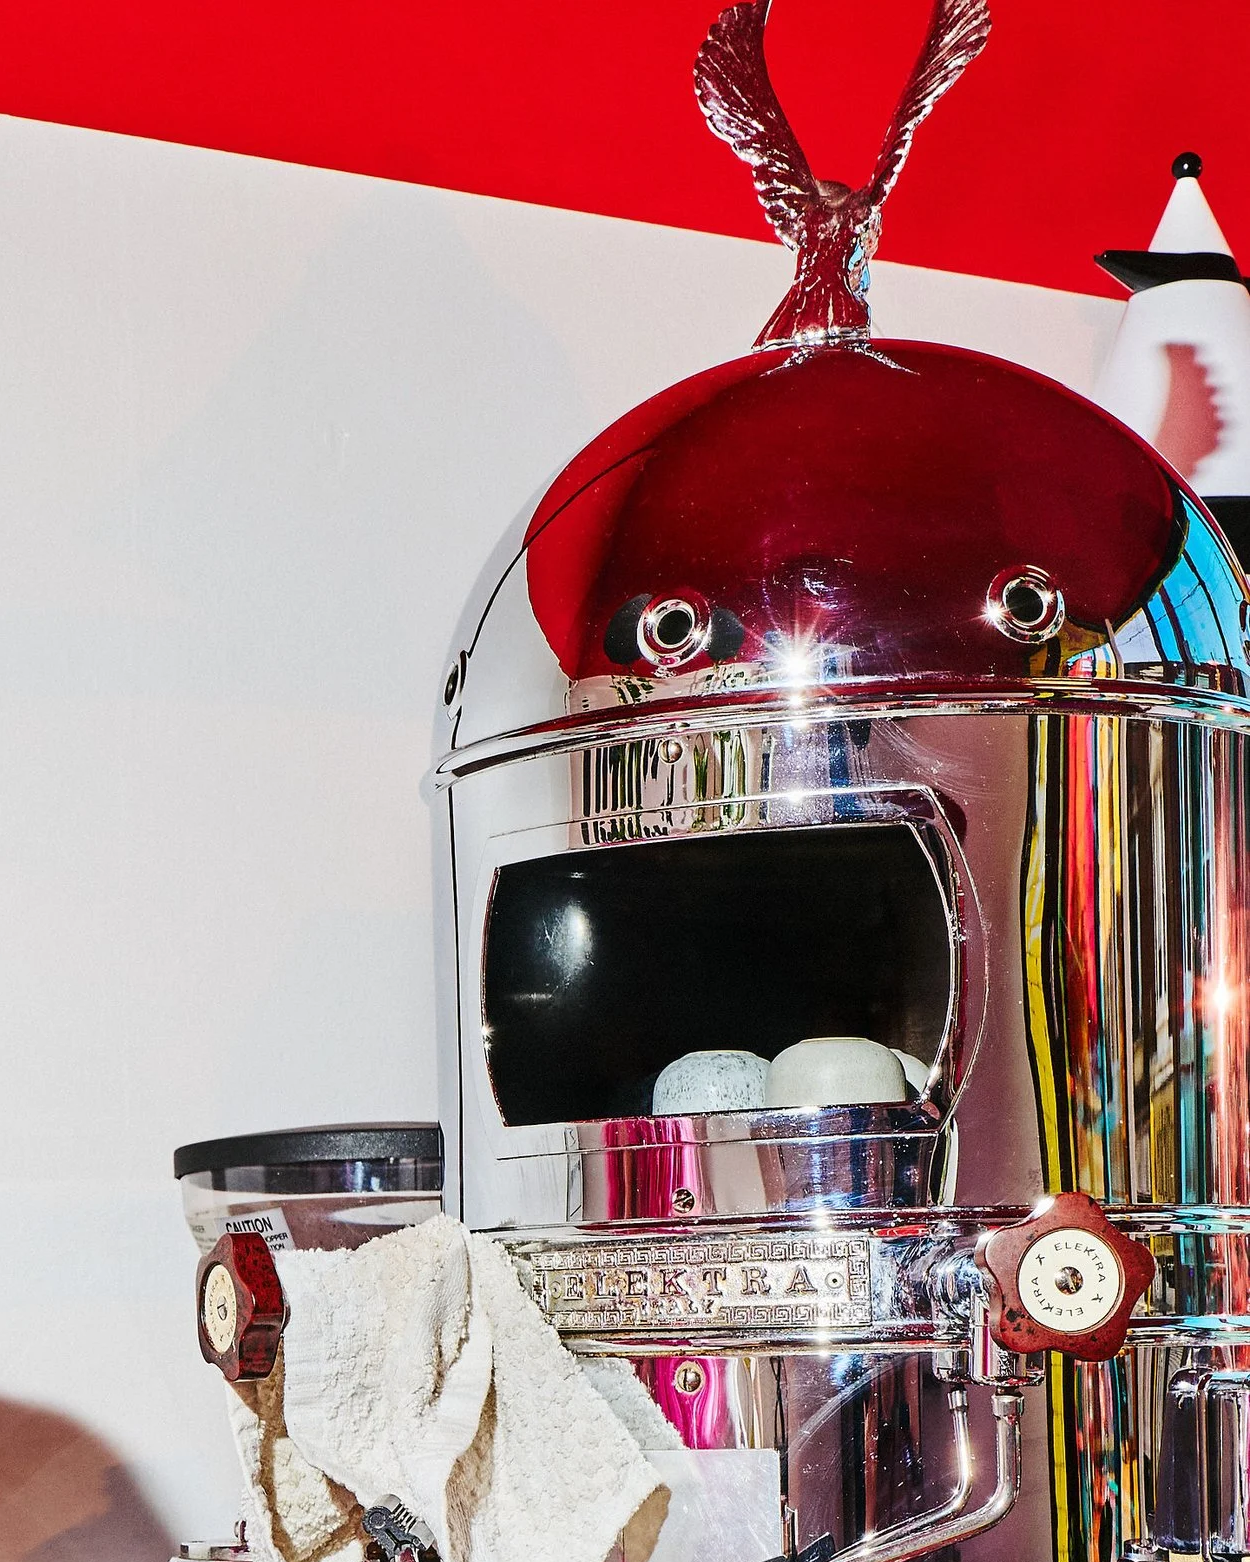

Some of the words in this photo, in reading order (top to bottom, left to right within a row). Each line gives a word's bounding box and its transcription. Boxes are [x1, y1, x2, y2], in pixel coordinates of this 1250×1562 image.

[225, 1216, 274, 1234] CAUTION
[1054, 1241, 1106, 1283] ELEKTRA
[562, 1265, 819, 1301] ELEKTRA
[1030, 1276, 1085, 1318] ELEKTRA
